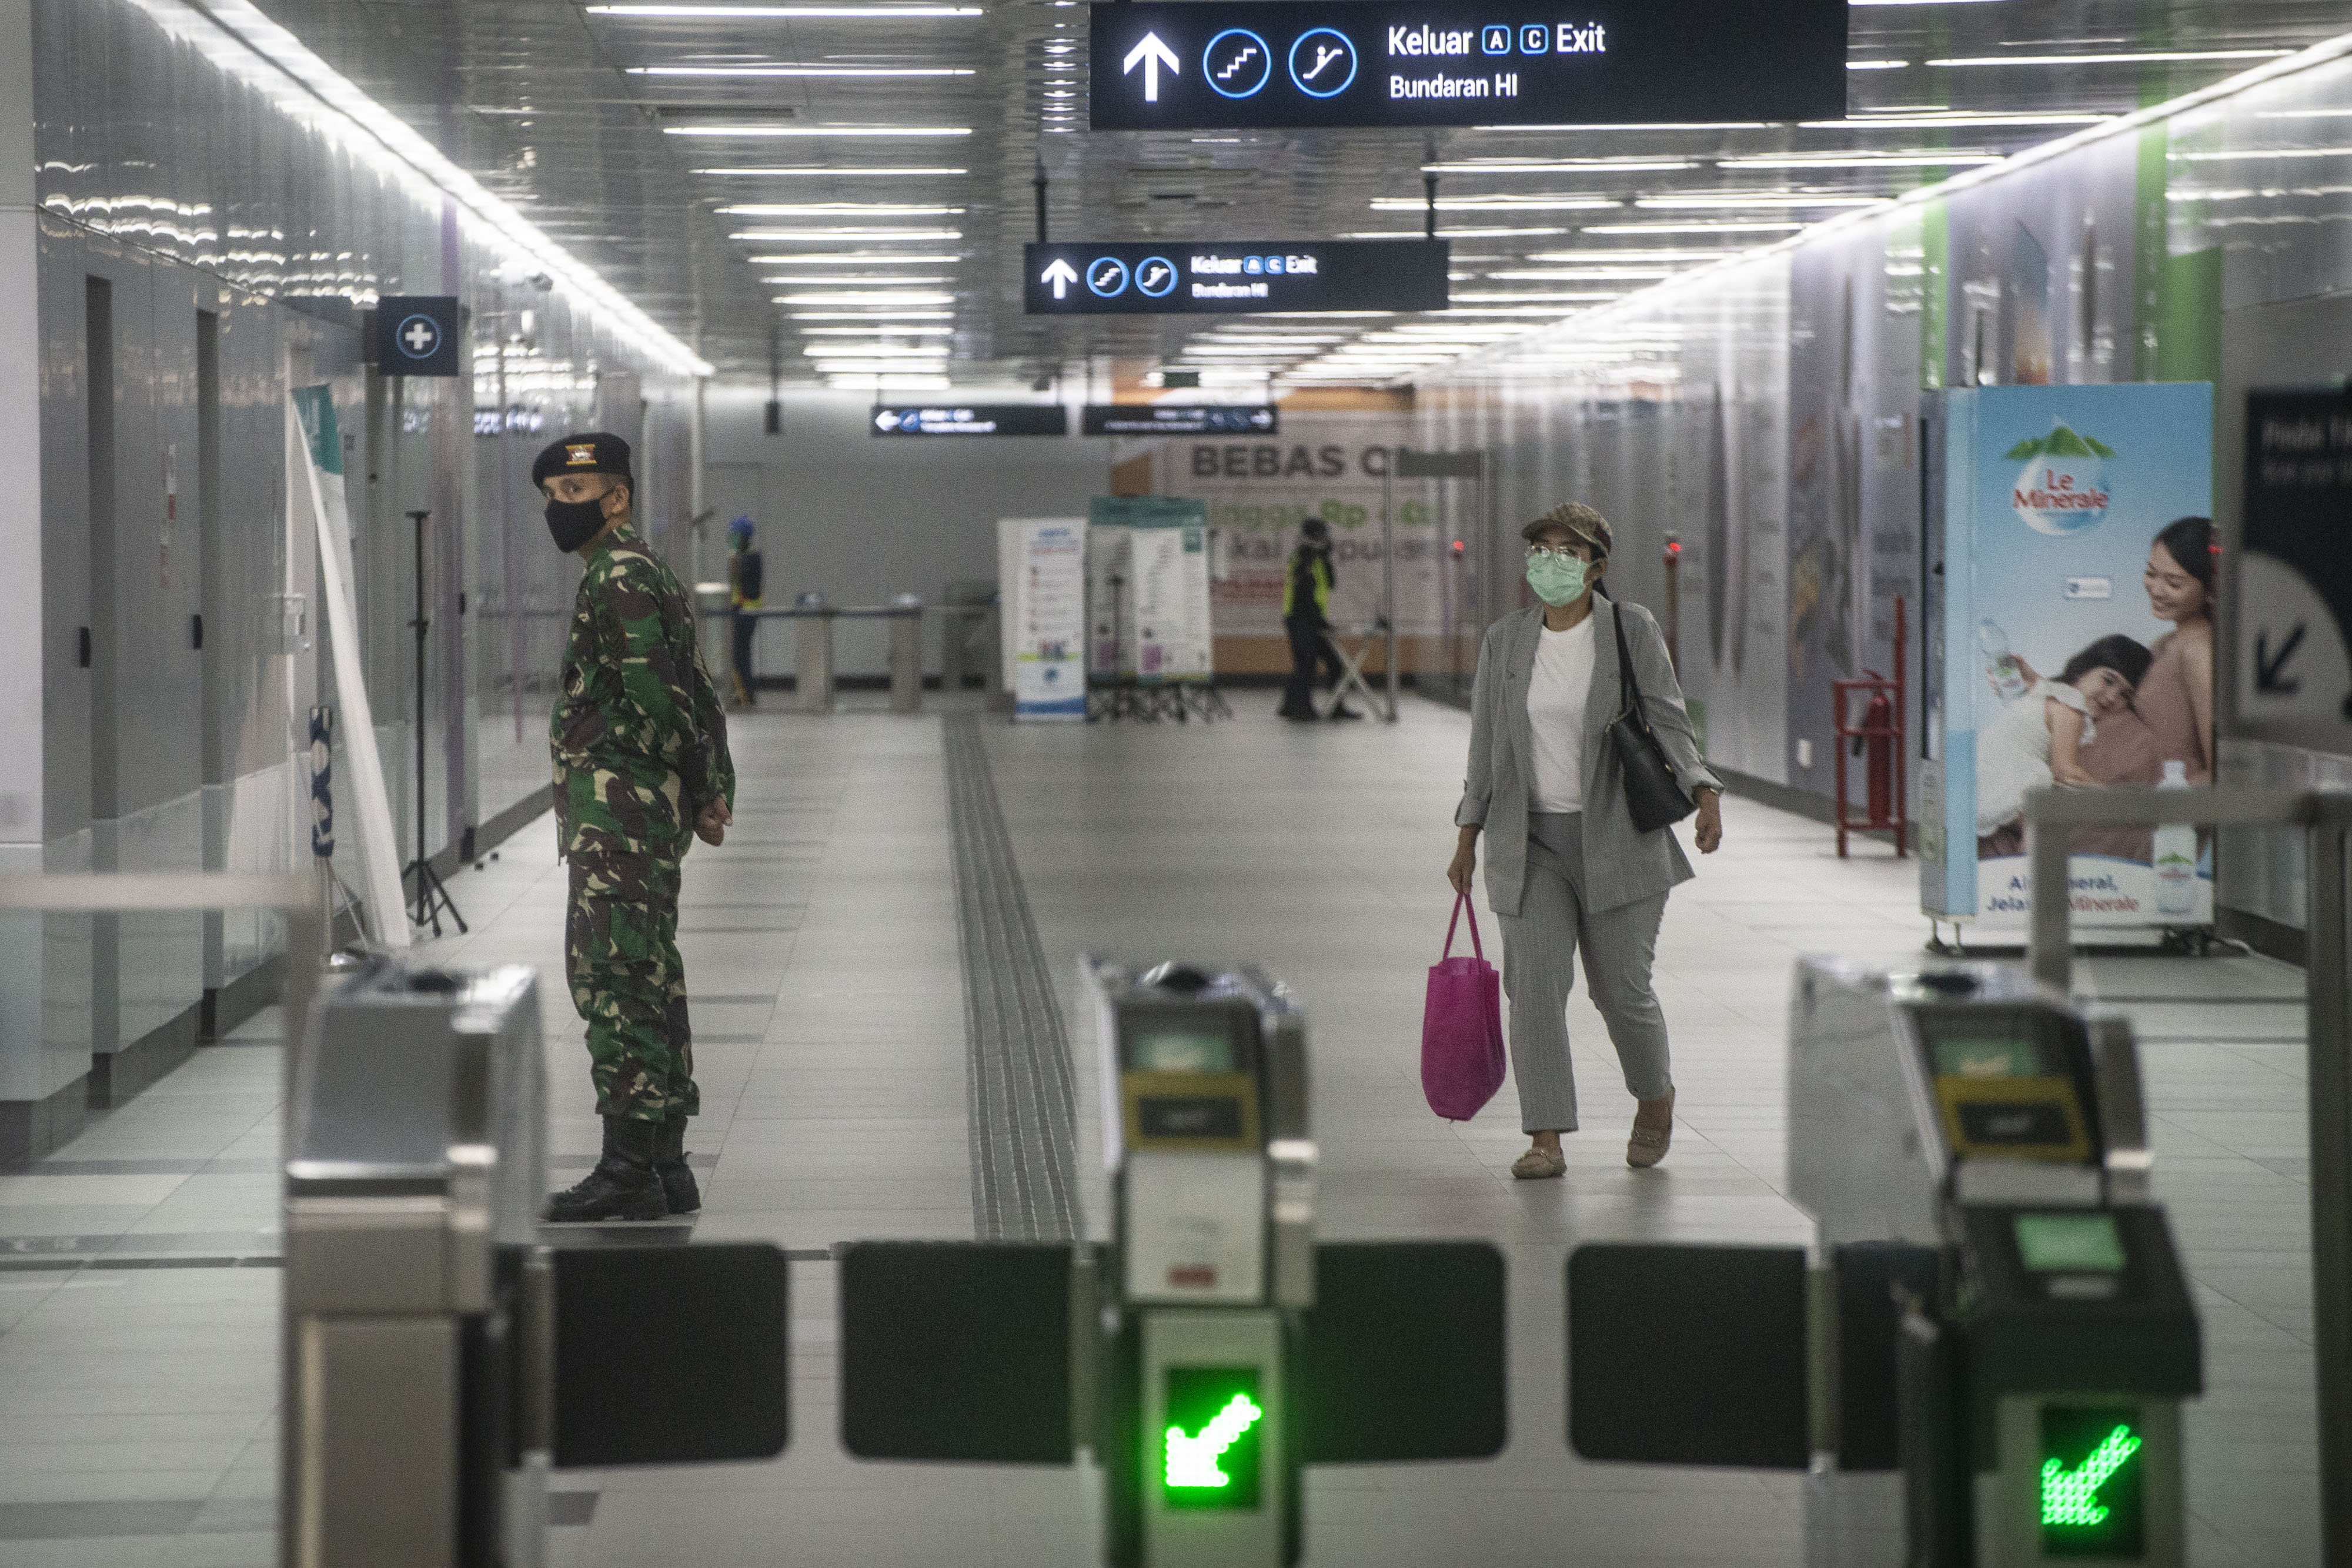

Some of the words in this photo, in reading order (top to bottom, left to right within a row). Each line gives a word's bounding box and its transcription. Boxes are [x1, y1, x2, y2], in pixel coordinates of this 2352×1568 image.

[1388, 24, 1474, 55] Keluar
[1489, 30, 1504, 49] A
[1528, 30, 1542, 48] C
[1556, 22, 1606, 52] Exit
[1390, 72, 1489, 98] Bundaran
[1495, 73, 1518, 97] HI
[1192, 445, 1347, 477] BEBAS
[2046, 469, 2074, 490] Le
[2013, 487, 2109, 509] Minerale
